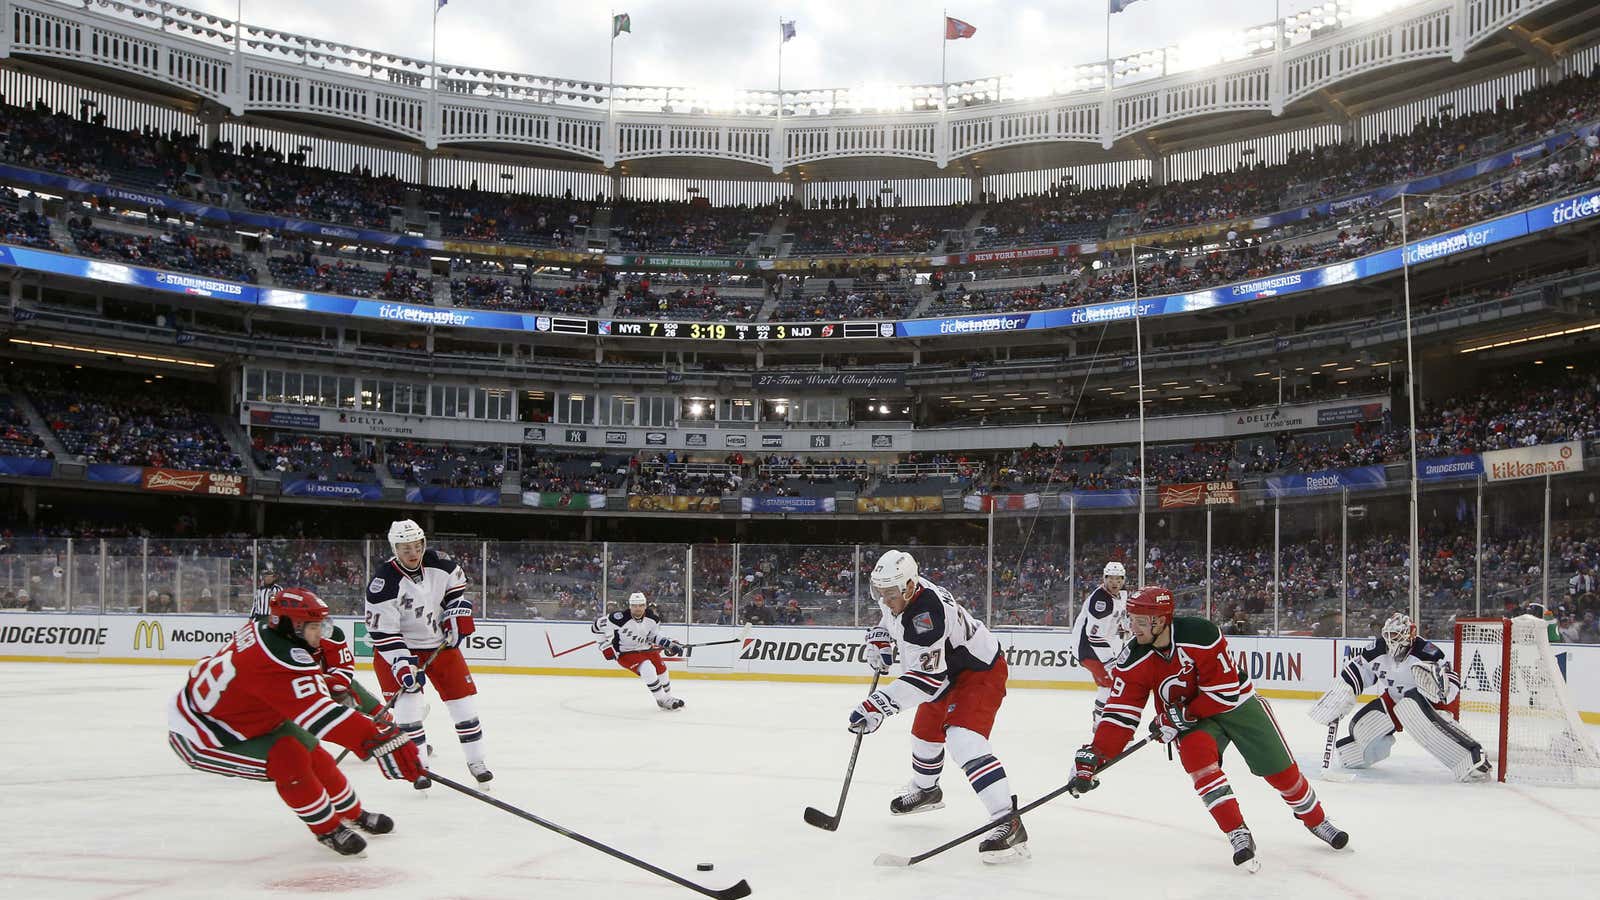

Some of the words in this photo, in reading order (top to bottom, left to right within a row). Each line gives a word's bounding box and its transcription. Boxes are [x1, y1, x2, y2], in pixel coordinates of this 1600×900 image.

[118, 191, 166, 206] HONDA
[1017, 248, 1054, 257] RANGERS
[670, 258, 700, 266] JERSEY
[702, 259, 730, 267] DEVILS
[619, 323, 641, 334] NYR
[649, 323, 658, 336] 7
[665, 329, 676, 337] 26
[690, 324, 726, 339] 3:19
[777, 326, 786, 339] 3
[792, 327, 812, 337] NJD
[806, 375, 839, 385] World
[842, 375, 897, 388] Champions
[350, 416, 384, 425] DELTA
[1246, 413, 1277, 423] DELTA
[1425, 460, 1475, 475] BRIDGESTONE
[1492, 459, 1566, 480] kikkoman
[209, 473, 242, 483] GRAB
[1306, 474, 1340, 488] Reebok
[208, 485, 241, 496] BUDS
[317, 485, 361, 494] HONDA
[1206, 482, 1234, 491] GRAB
[1205, 496, 1234, 505] BUDS
[365, 610, 381, 631] 21
[171, 629, 237, 643] McDona
[740, 638, 901, 664] BRIDGESTOE
[919, 648, 941, 673] 27
[1230, 650, 1302, 682] ADIAN
[290, 673, 332, 699] 68
[1322, 725, 1335, 769] BAUER
